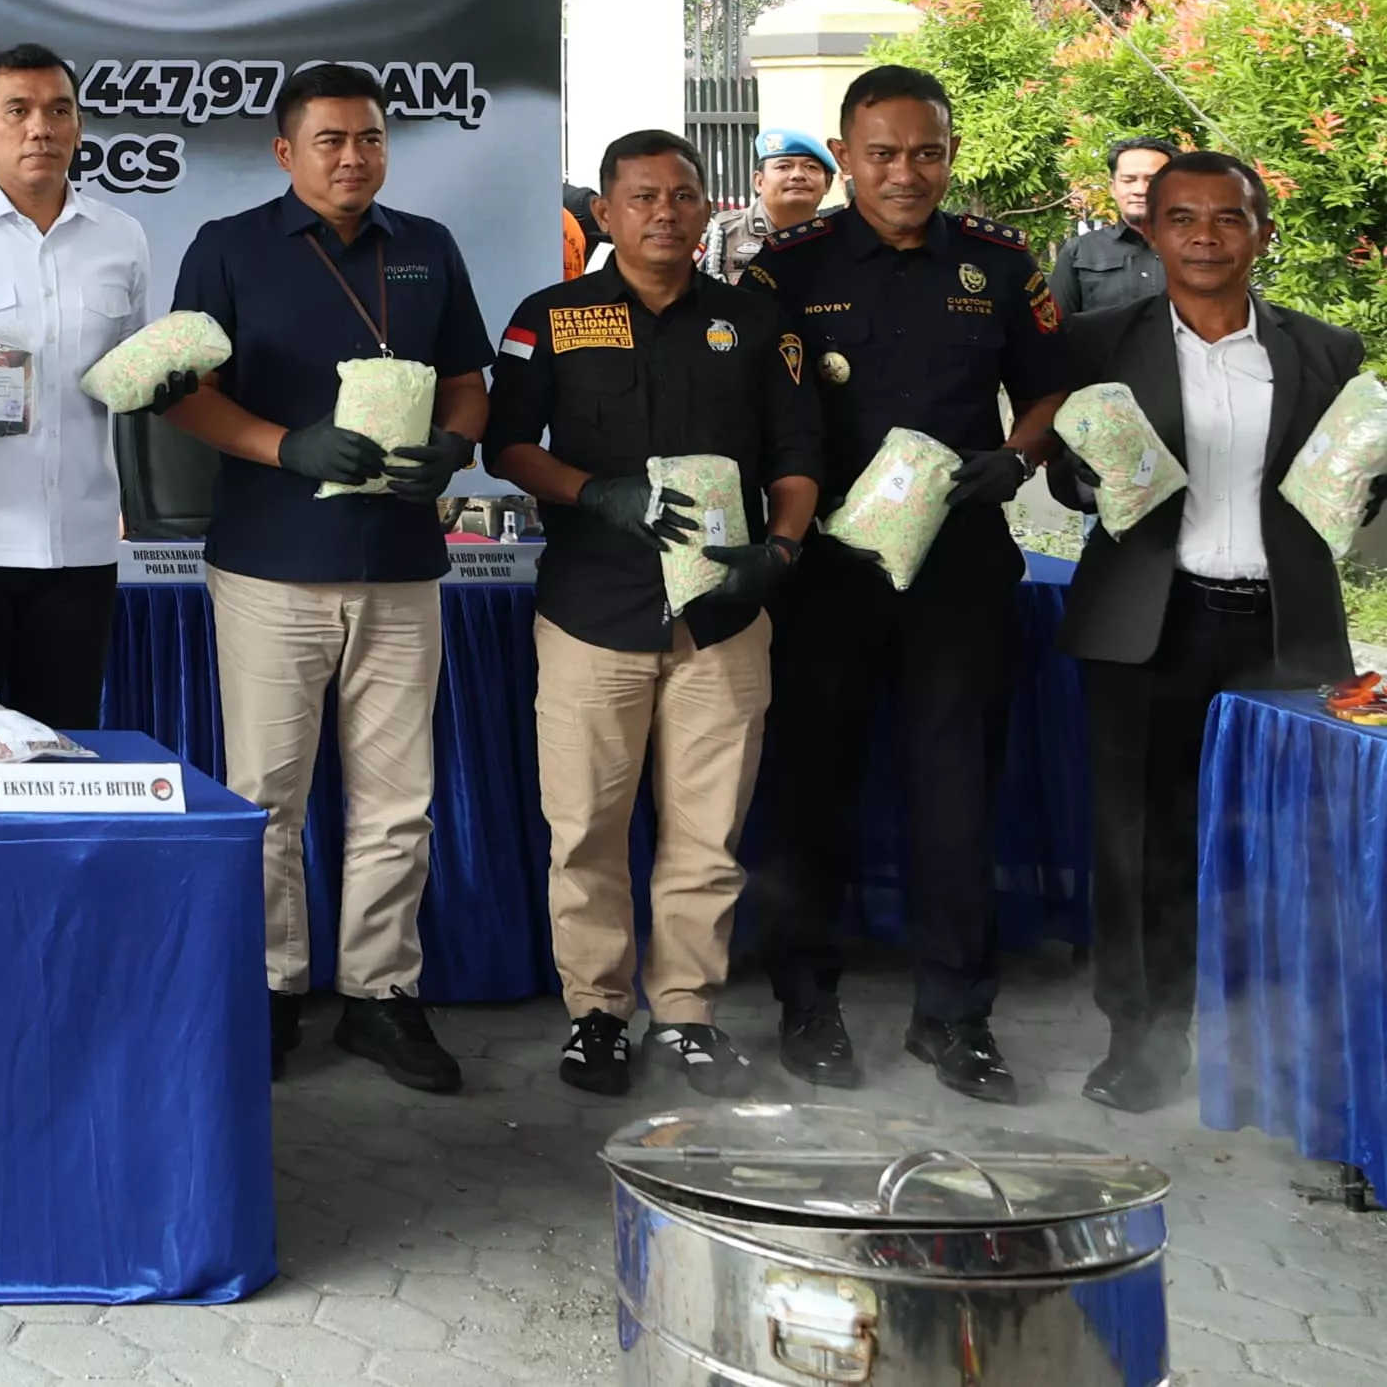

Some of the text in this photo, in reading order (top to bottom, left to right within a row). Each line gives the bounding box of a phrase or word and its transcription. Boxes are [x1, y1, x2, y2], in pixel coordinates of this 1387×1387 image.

[86, 66, 279, 117] 447,97
[73, 140, 180, 182] PCS
[553, 306, 626, 320] GERAKAN
[554, 316, 626, 329] NASIONAL
[145, 563, 198, 575] POLDA RIAU
[3, 781, 146, 796] EKSTASI 57.115 BUTIR
